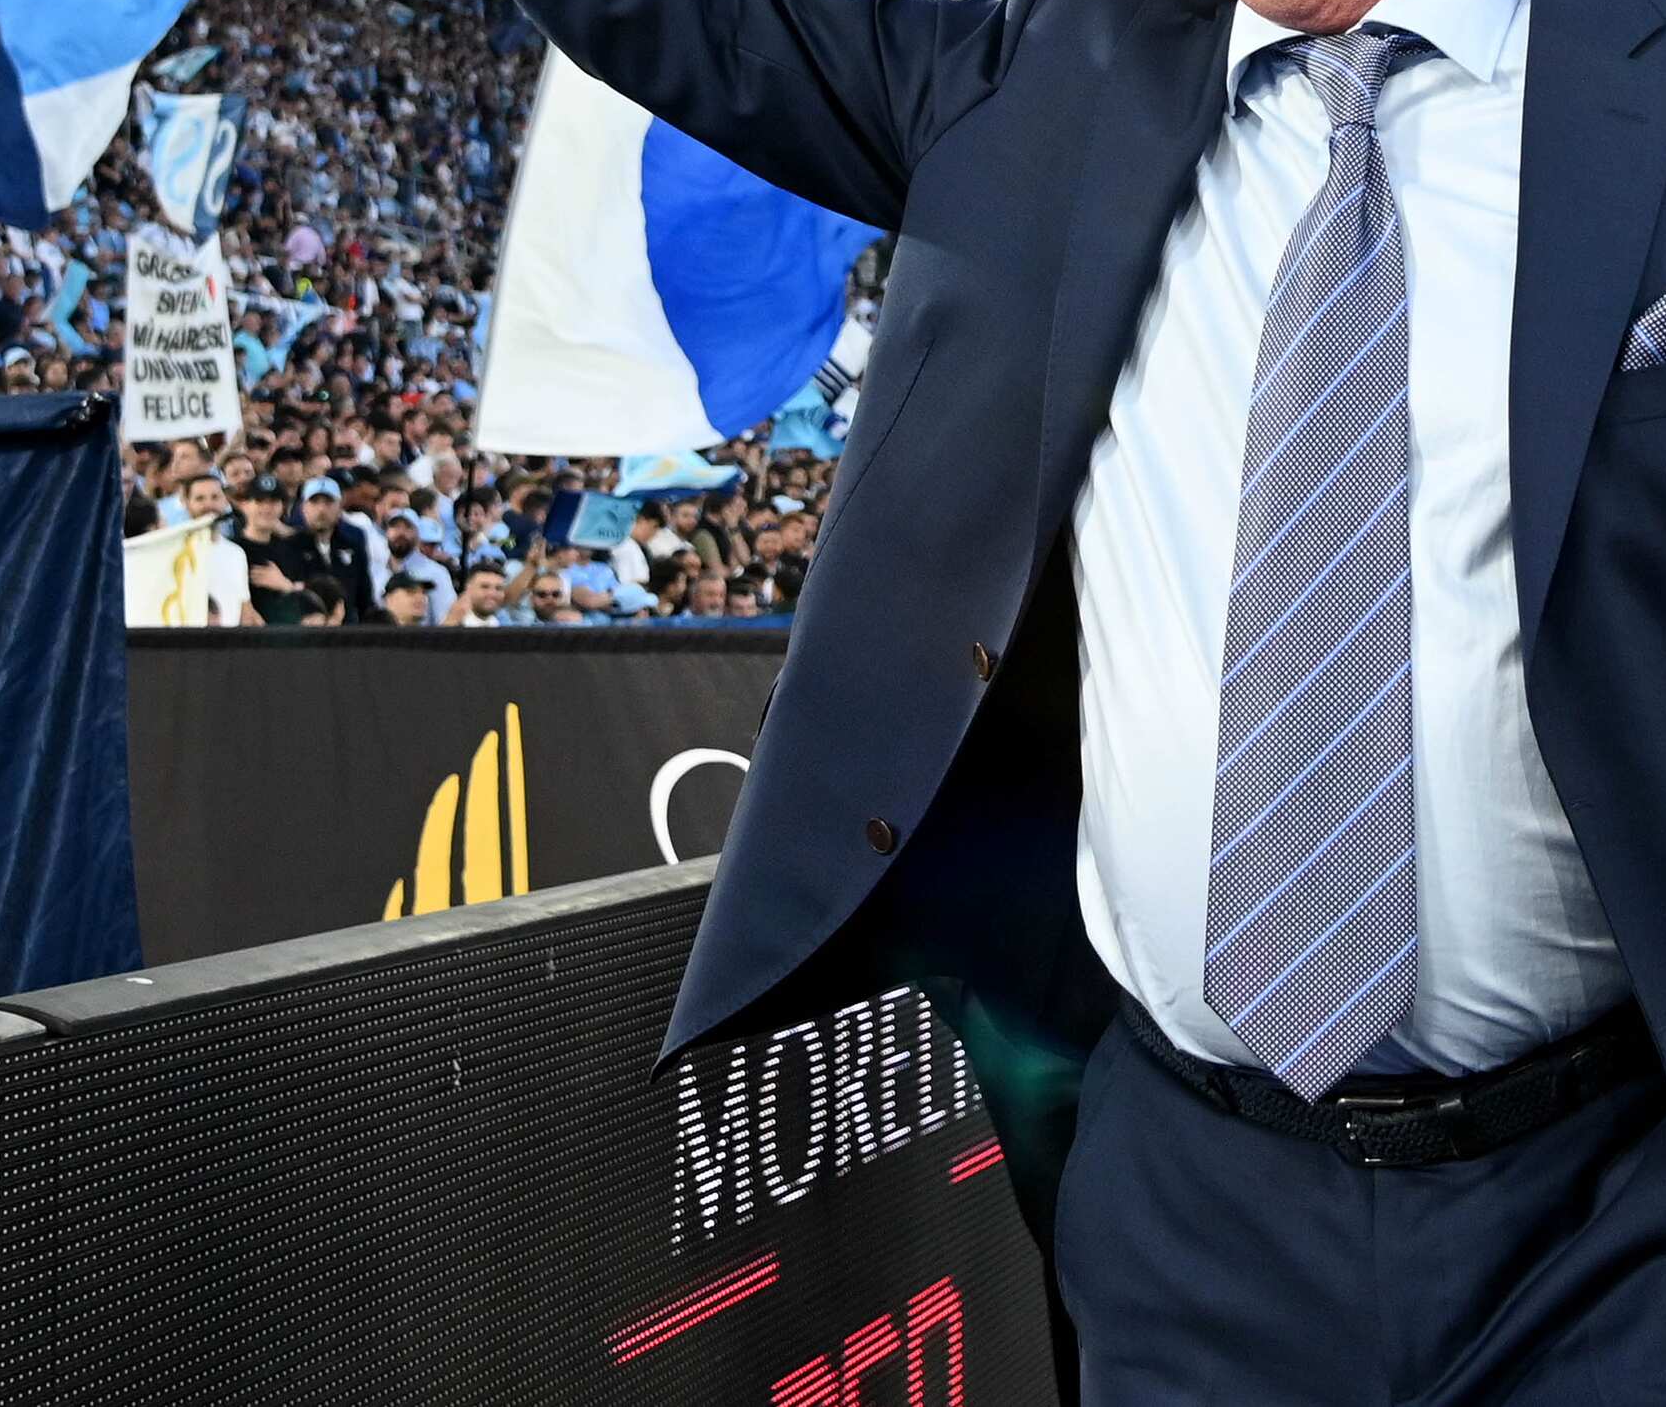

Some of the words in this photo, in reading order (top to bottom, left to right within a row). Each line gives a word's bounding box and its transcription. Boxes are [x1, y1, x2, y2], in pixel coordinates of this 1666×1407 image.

[157, 290, 201, 314] SVEN
[142, 388, 214, 420] FELICE
[671, 987, 983, 1257] MORELI
